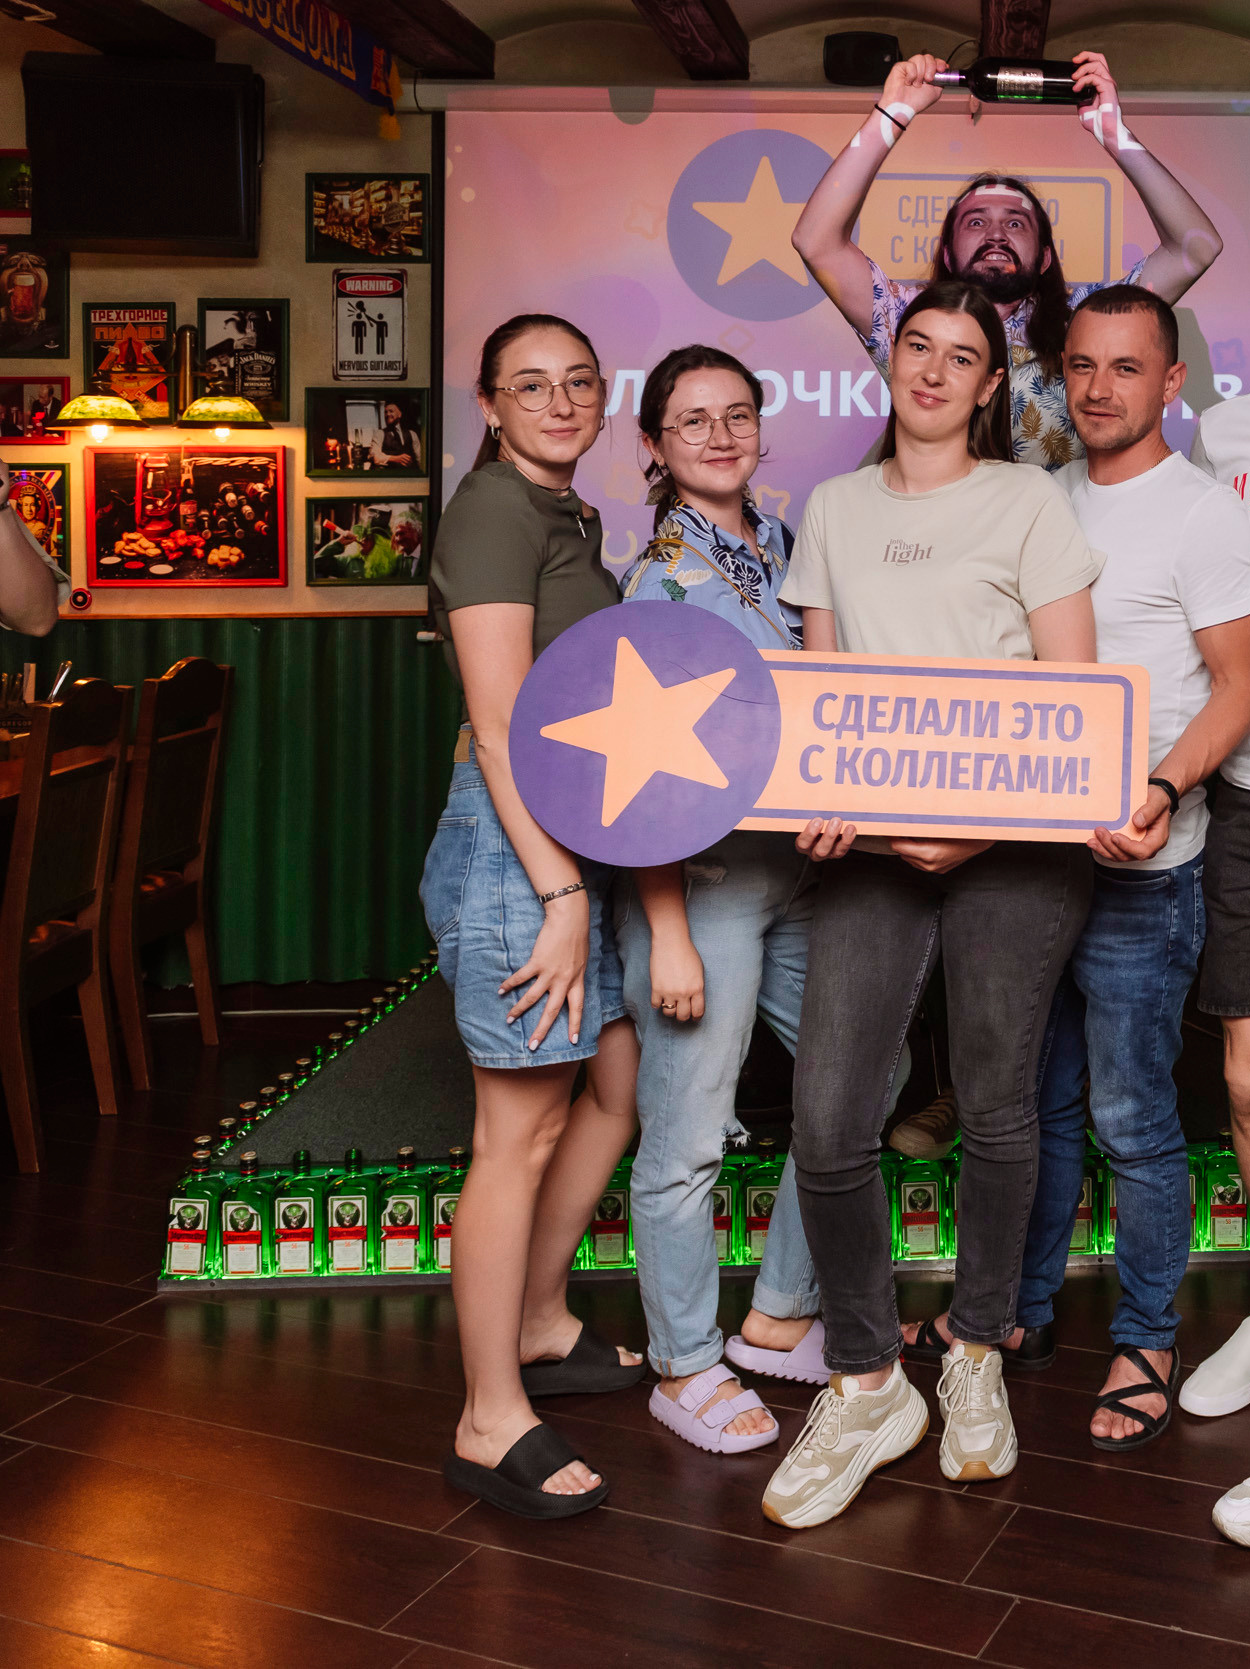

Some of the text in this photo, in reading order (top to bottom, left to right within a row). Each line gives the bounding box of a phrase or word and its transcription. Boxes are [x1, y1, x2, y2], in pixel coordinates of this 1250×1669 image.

[345, 280, 394, 292] WARNING
[91, 310, 167, 321] ТРЕХГОРНОЕ
[339, 360, 401, 371] NERVOUS GUITARIST
[882, 543, 933, 566] light
[812, 692, 1084, 742] СДЕЛАЛИ ЭТО
[799, 744, 1091, 796] С КОЛЛЕГАМИ!
